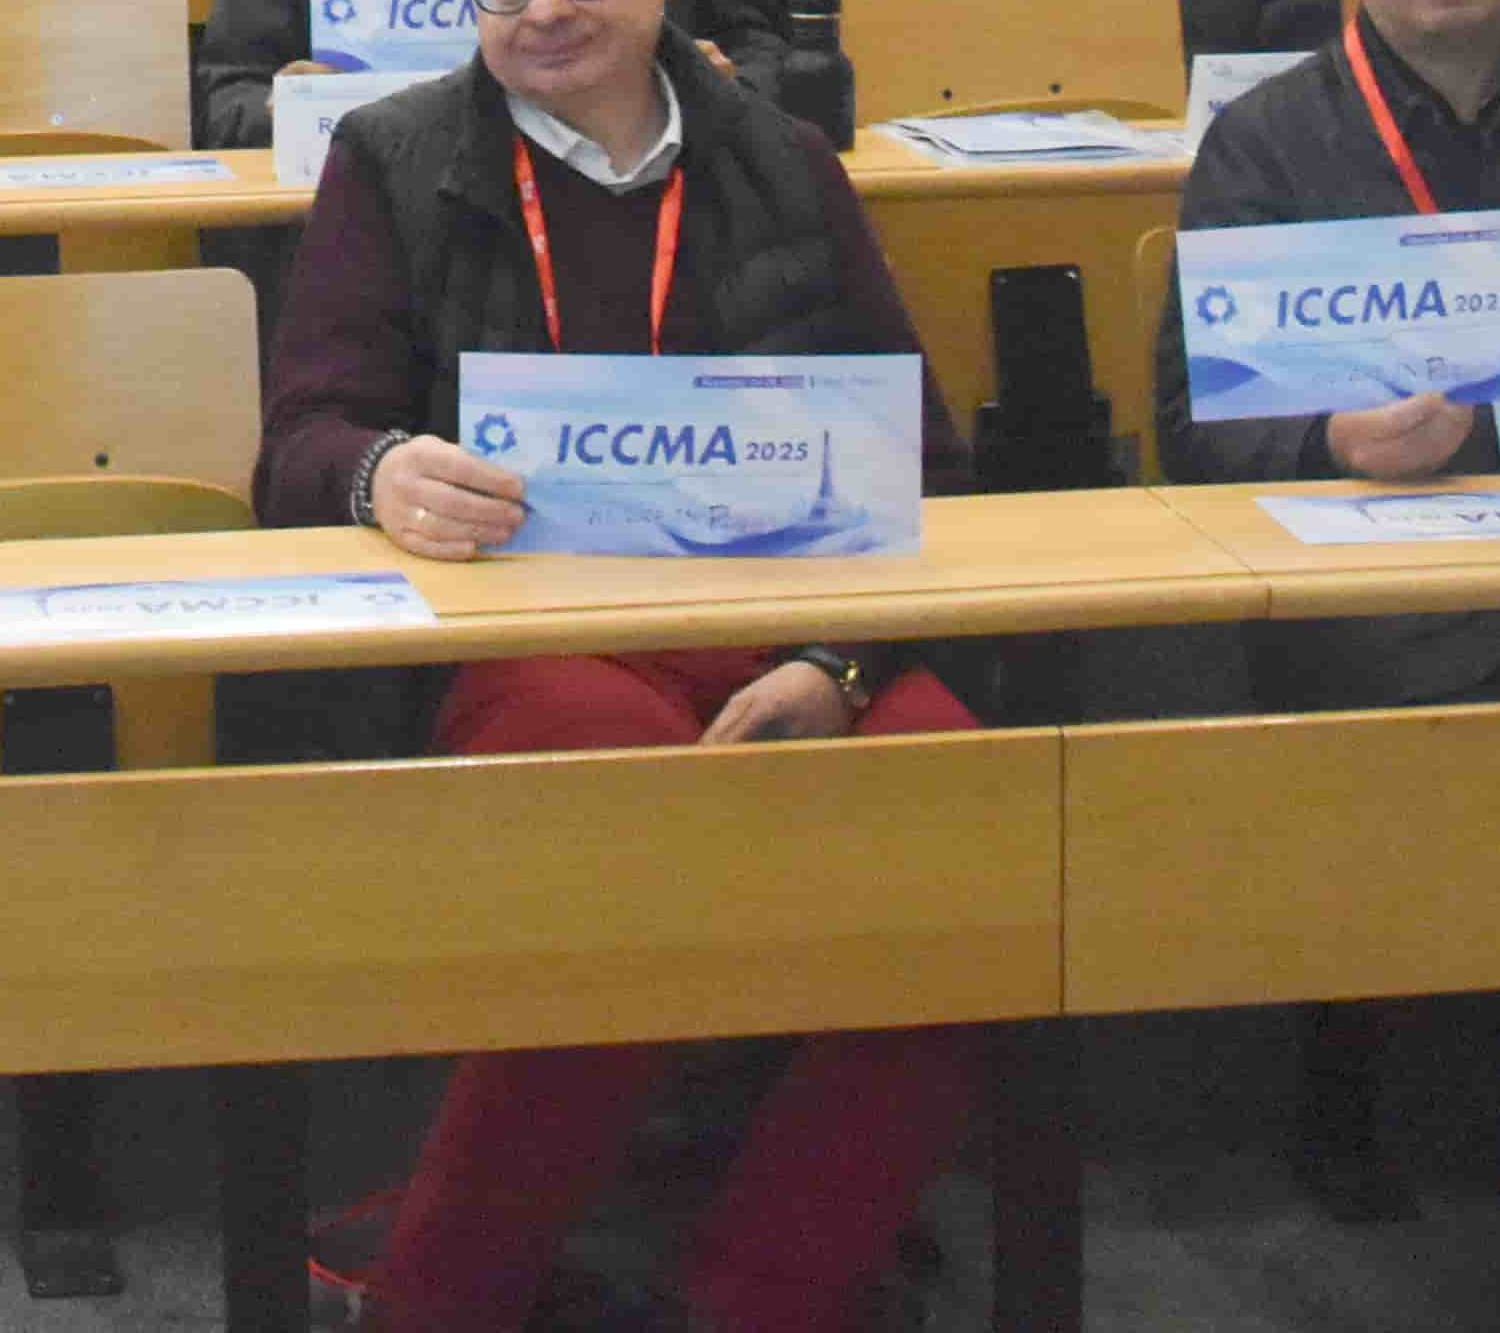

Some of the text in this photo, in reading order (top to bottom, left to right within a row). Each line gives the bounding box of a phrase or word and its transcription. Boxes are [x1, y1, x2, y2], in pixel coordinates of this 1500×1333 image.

[1276, 281, 1449, 330] ICCMA
[555, 422, 809, 466] ICCMA 2025
